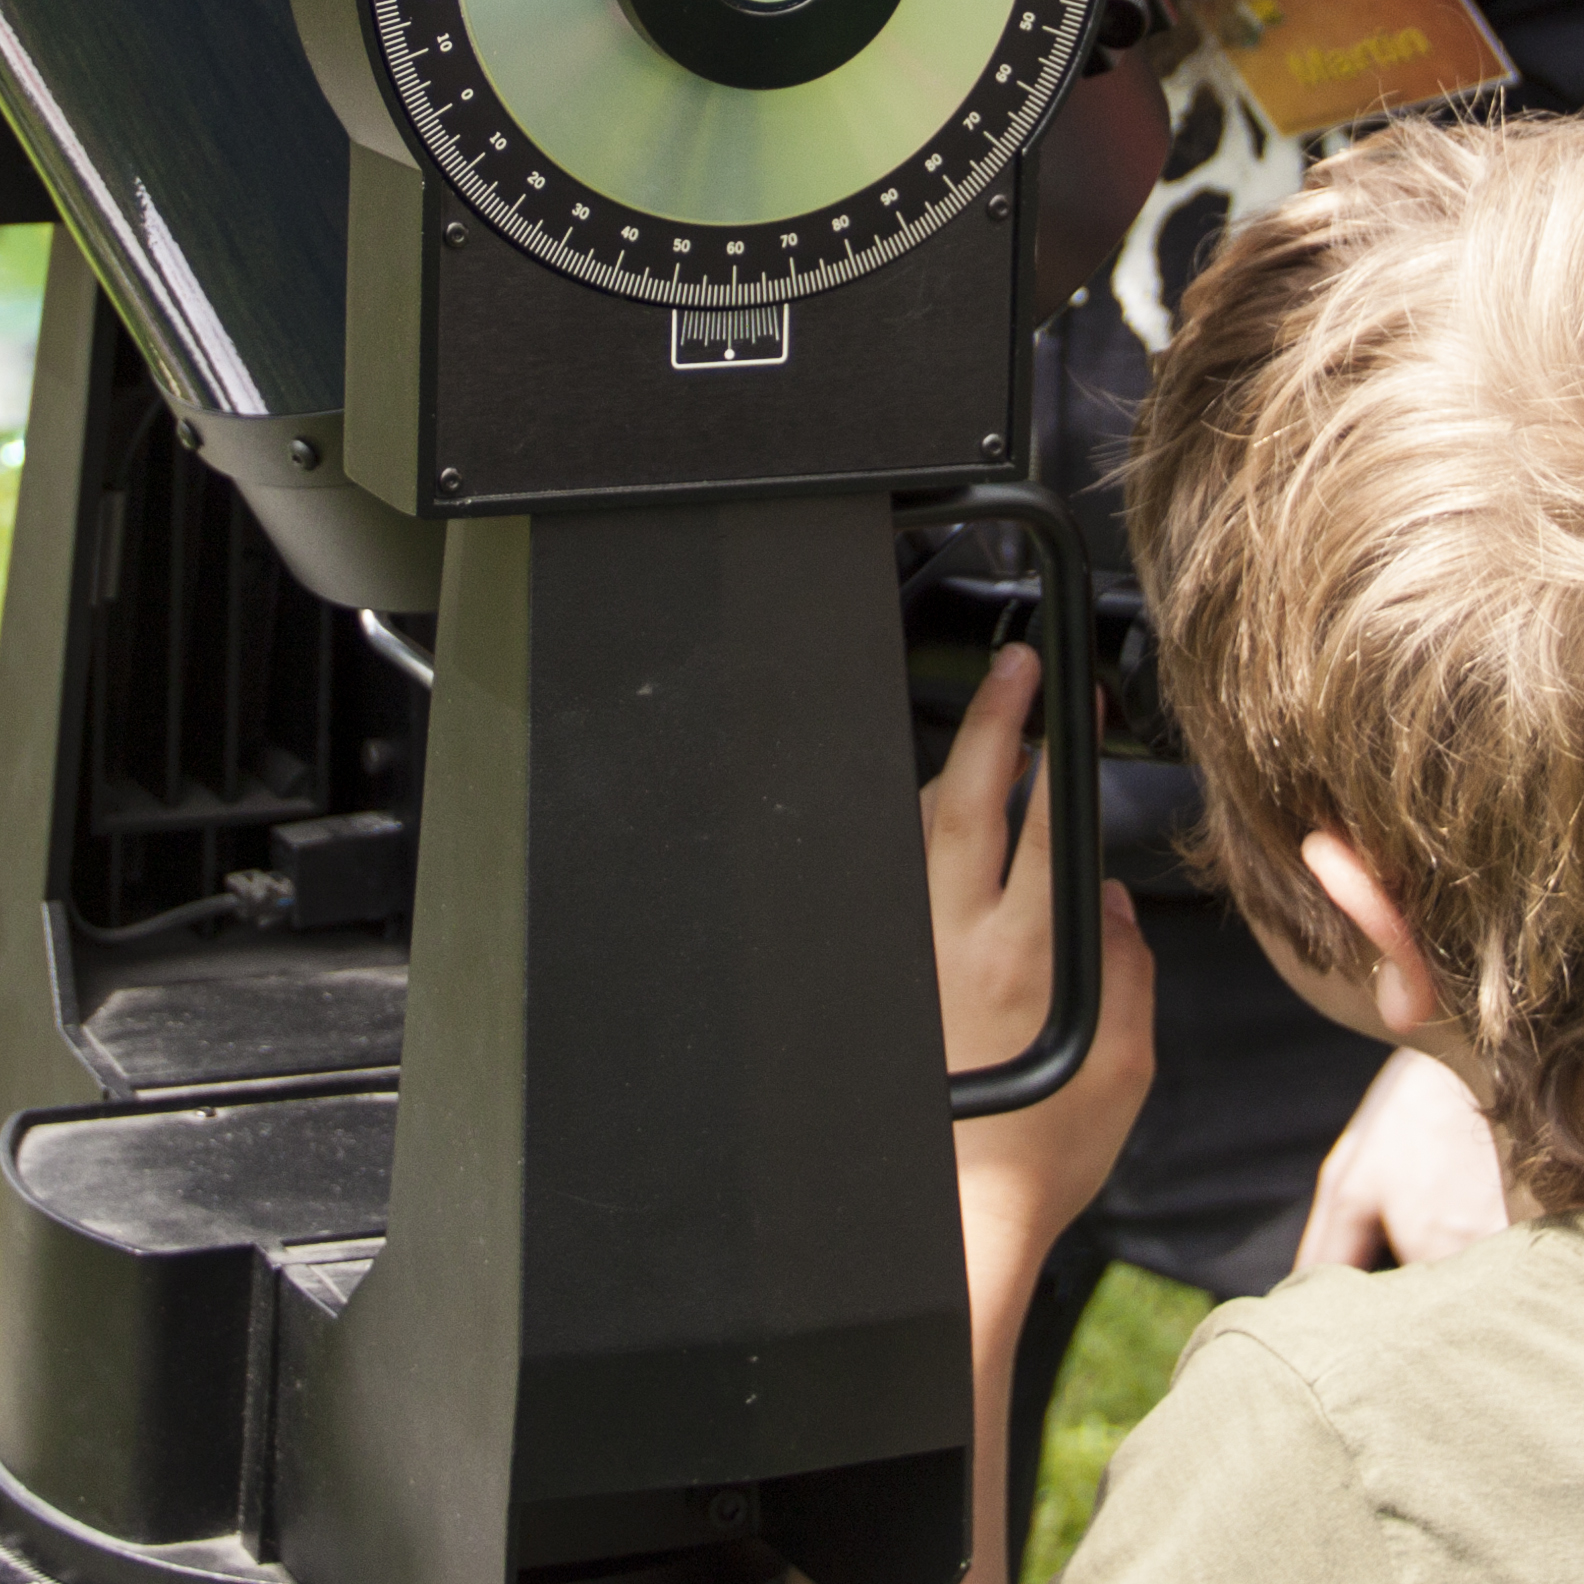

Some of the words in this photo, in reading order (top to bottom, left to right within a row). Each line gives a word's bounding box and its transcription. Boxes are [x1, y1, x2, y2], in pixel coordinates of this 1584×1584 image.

[1019, 11, 1036, 31] 50
[436, 32, 453, 53] 10
[995, 63, 1012, 83] 60
[460, 88, 474, 101] 0
[962, 111, 981, 131] 70
[489, 131, 507, 151] 10
[924, 153, 943, 172] 80
[526, 170, 546, 190] 20
[880, 187, 899, 206] 90
[571, 202, 590, 220] 30
[831, 214, 850, 232] 80
[620, 225, 639, 242] 40
[780, 232, 798, 248] 70
[672, 238, 691, 253] 50
[726, 240, 745, 255] 60
